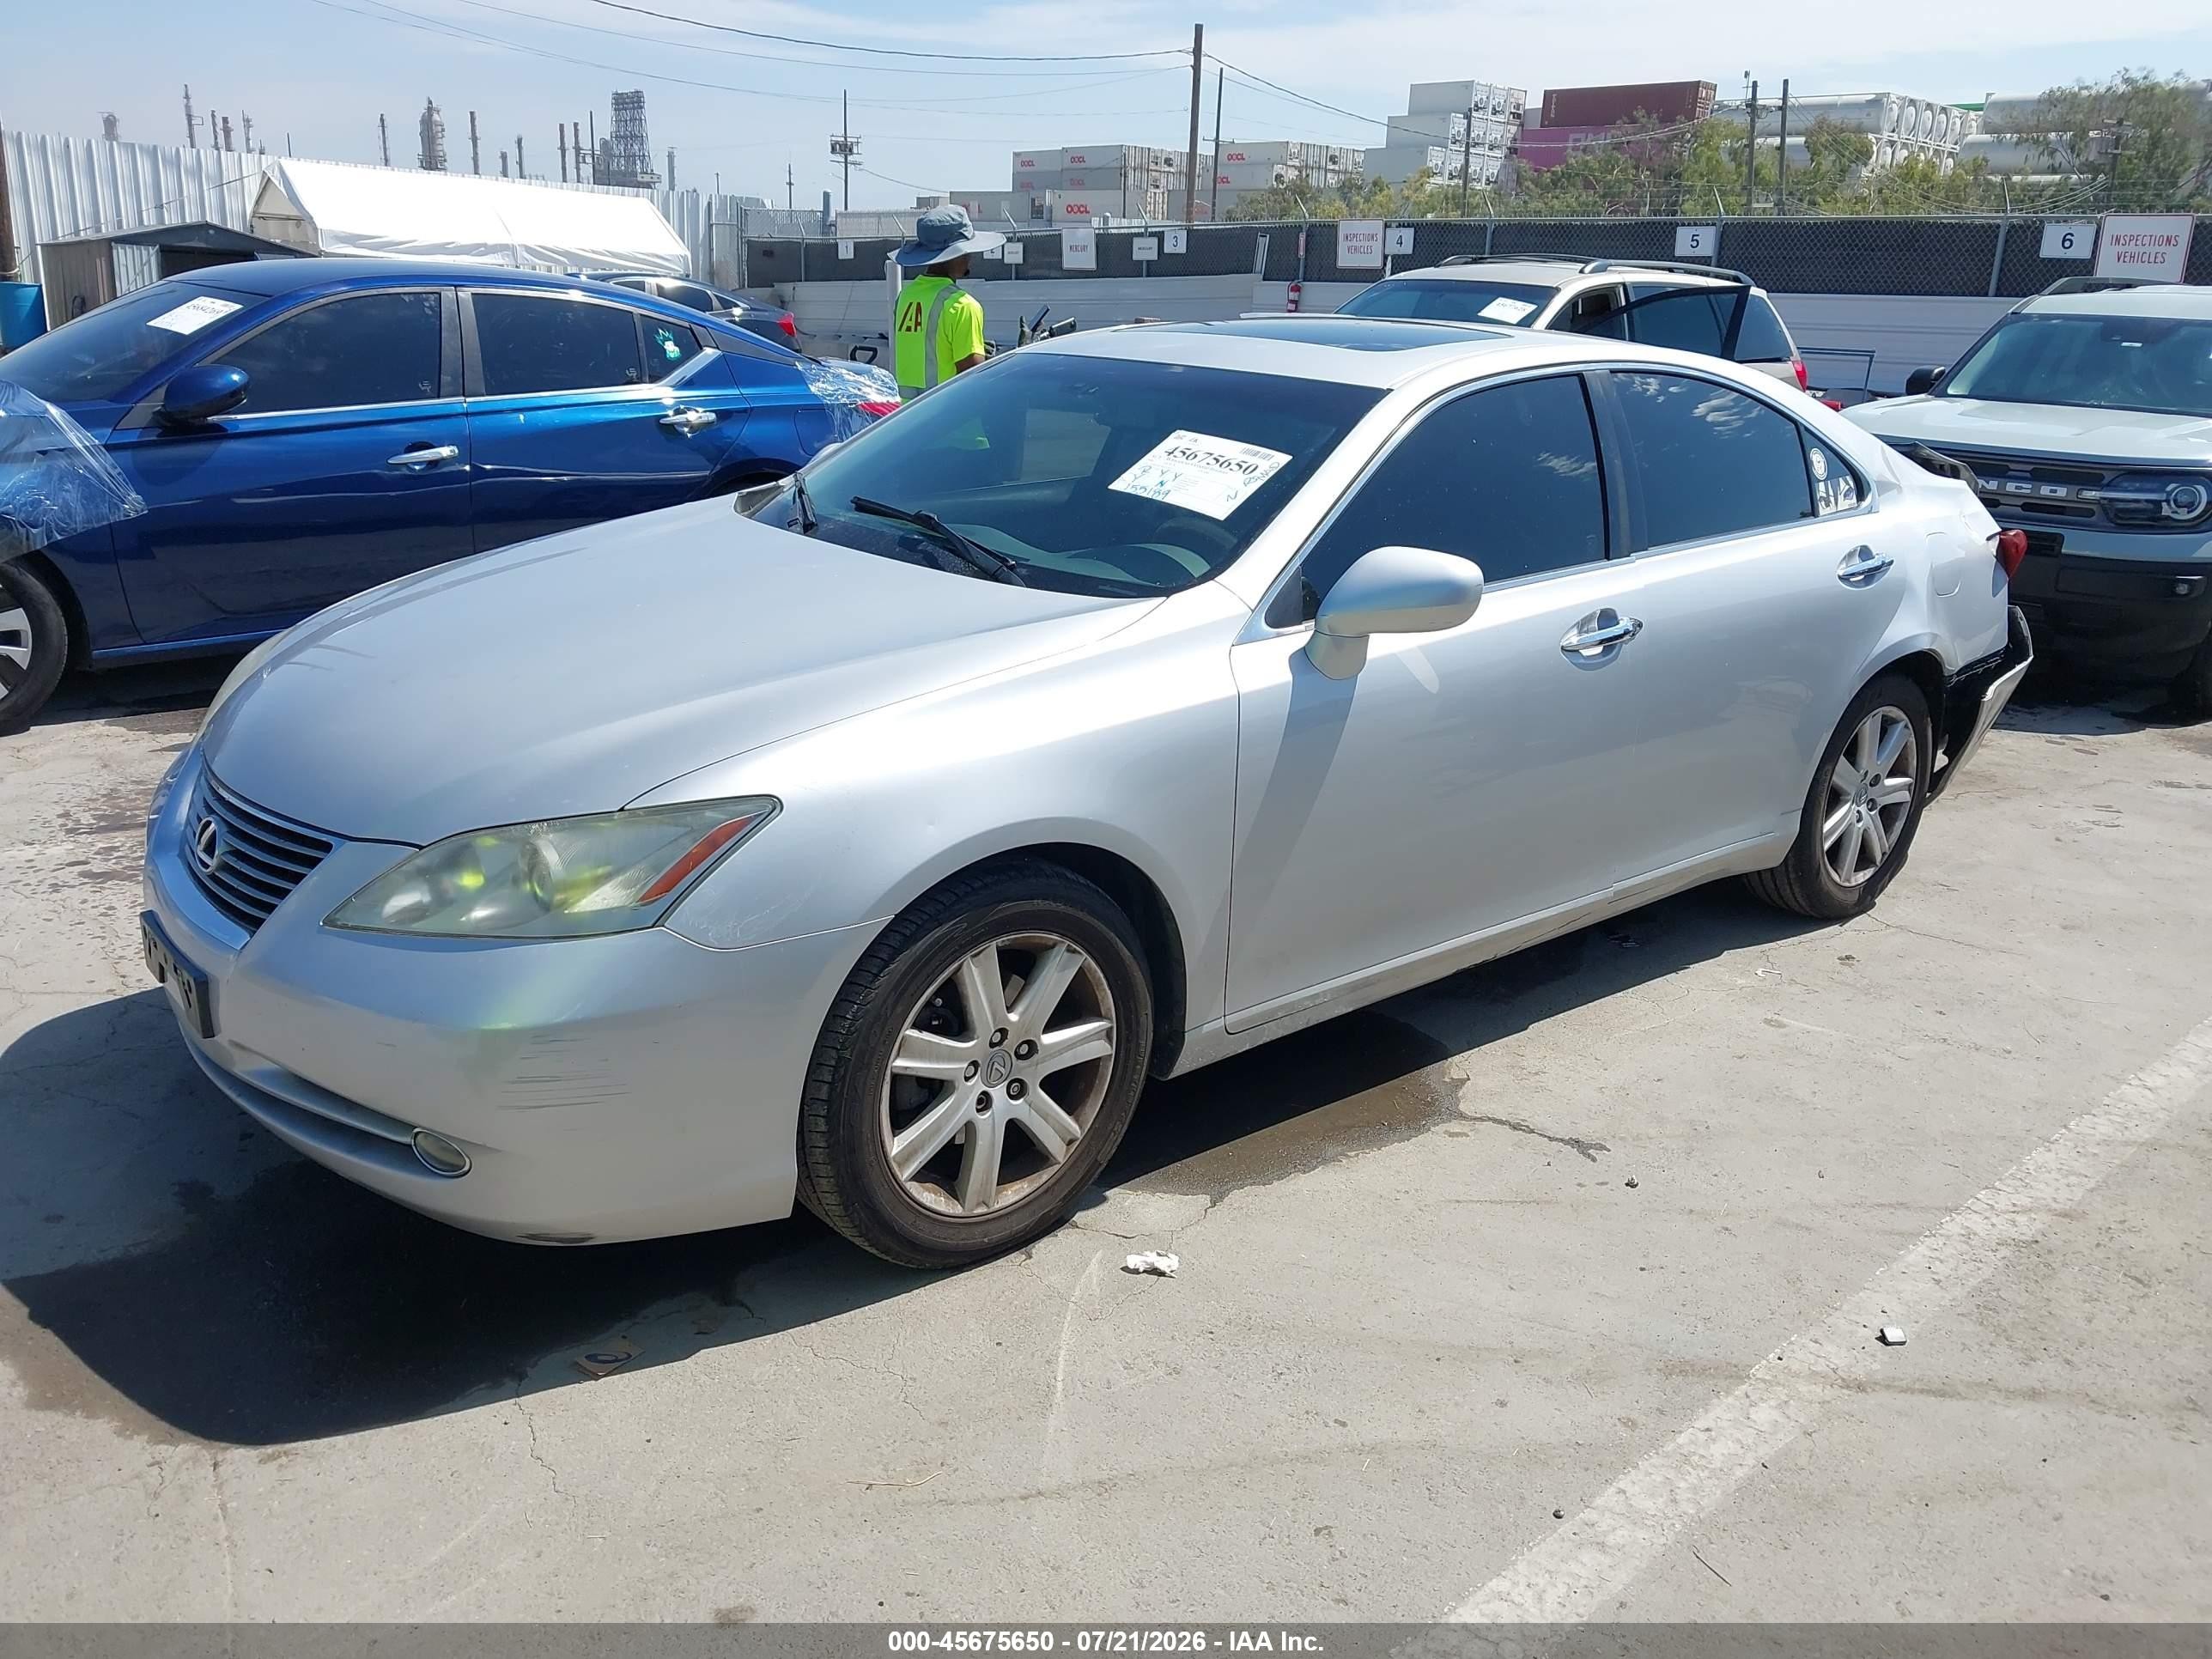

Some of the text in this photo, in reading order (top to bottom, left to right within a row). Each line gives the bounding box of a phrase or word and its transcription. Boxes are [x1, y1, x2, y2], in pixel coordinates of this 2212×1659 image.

[1226, 153, 1246, 161] OOCL
[1066, 204, 1091, 214] OOCL
[1172, 235, 1179, 248] 3
[1343, 233, 1378, 242] INSPECTIONS
[1395, 234, 1403, 247] 4
[1690, 234, 1700, 249] 5
[2061, 233, 2075, 250] 6
[2110, 234, 2180, 247] INSPECTIONS
[1069, 245, 1089, 253] MERCURY
[1346, 246, 1373, 255] VEHICLES
[2117, 252, 2167, 264] VEHICLES
[1164, 446, 1260, 476] 45675650
